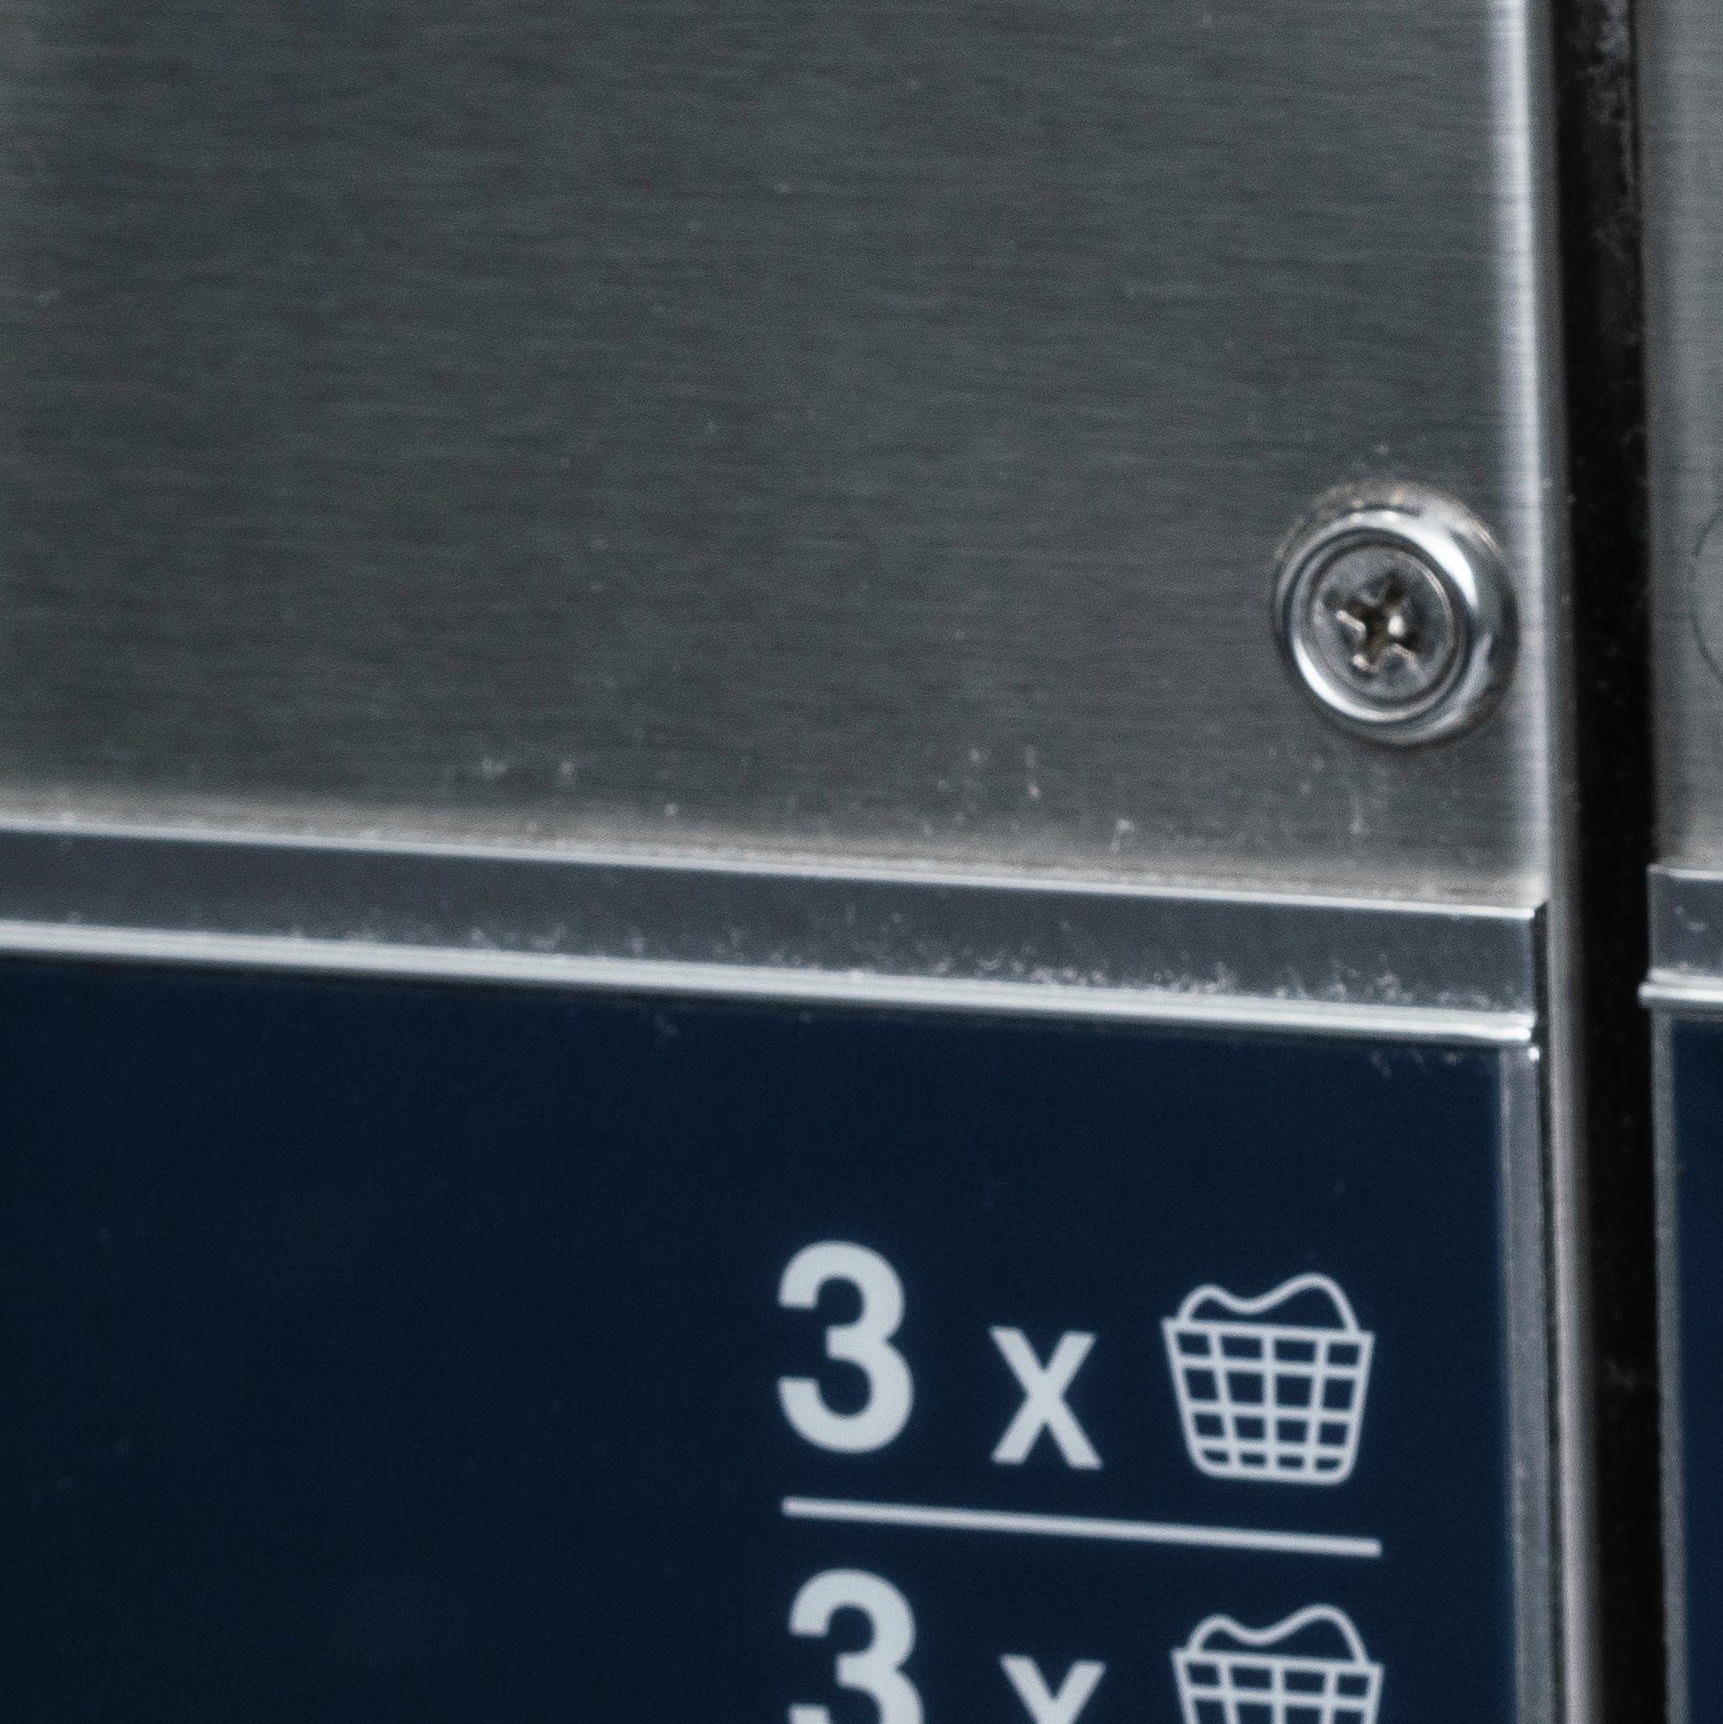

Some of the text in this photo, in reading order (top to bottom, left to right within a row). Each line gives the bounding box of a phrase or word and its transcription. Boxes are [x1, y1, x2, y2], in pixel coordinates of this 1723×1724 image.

[779, 1241, 1101, 1469] 3 x
[790, 1569, 924, 1724] 3
